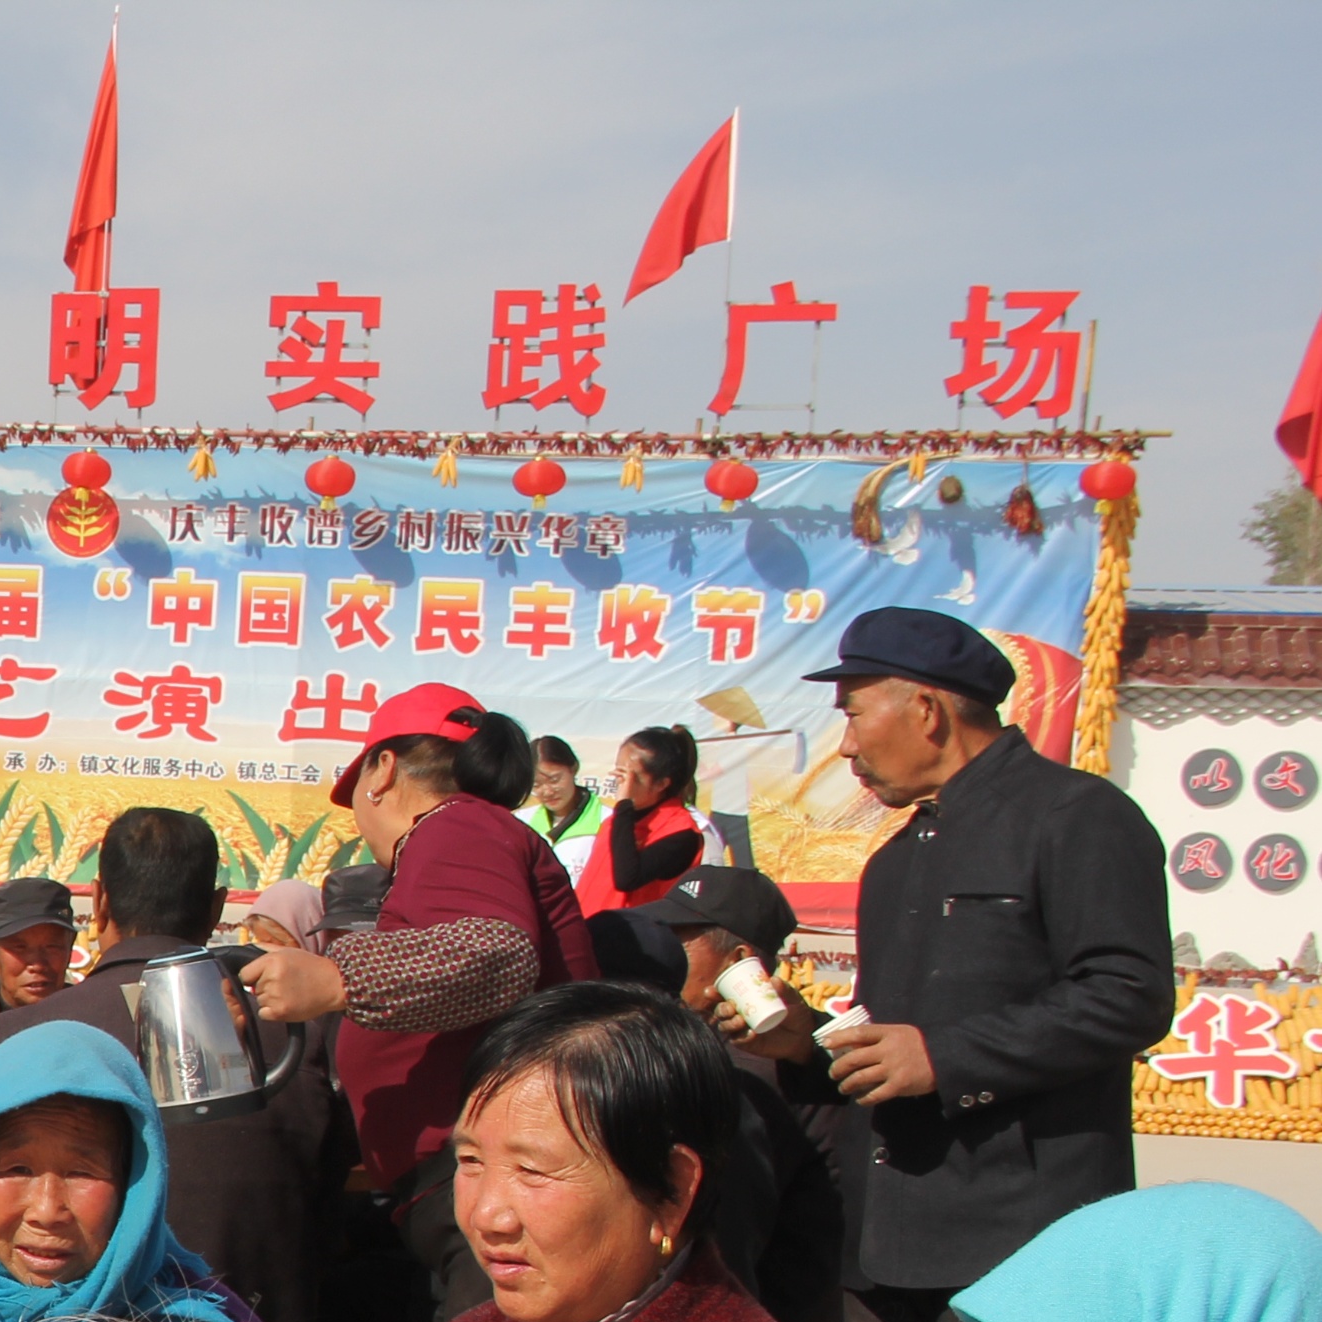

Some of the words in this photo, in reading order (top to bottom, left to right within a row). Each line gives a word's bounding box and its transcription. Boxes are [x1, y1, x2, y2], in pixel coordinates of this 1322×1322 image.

[167, 503, 626, 558] 庆丰收谱乡村振兴华章
[79, 755, 225, 779] 镇文化服务中心
